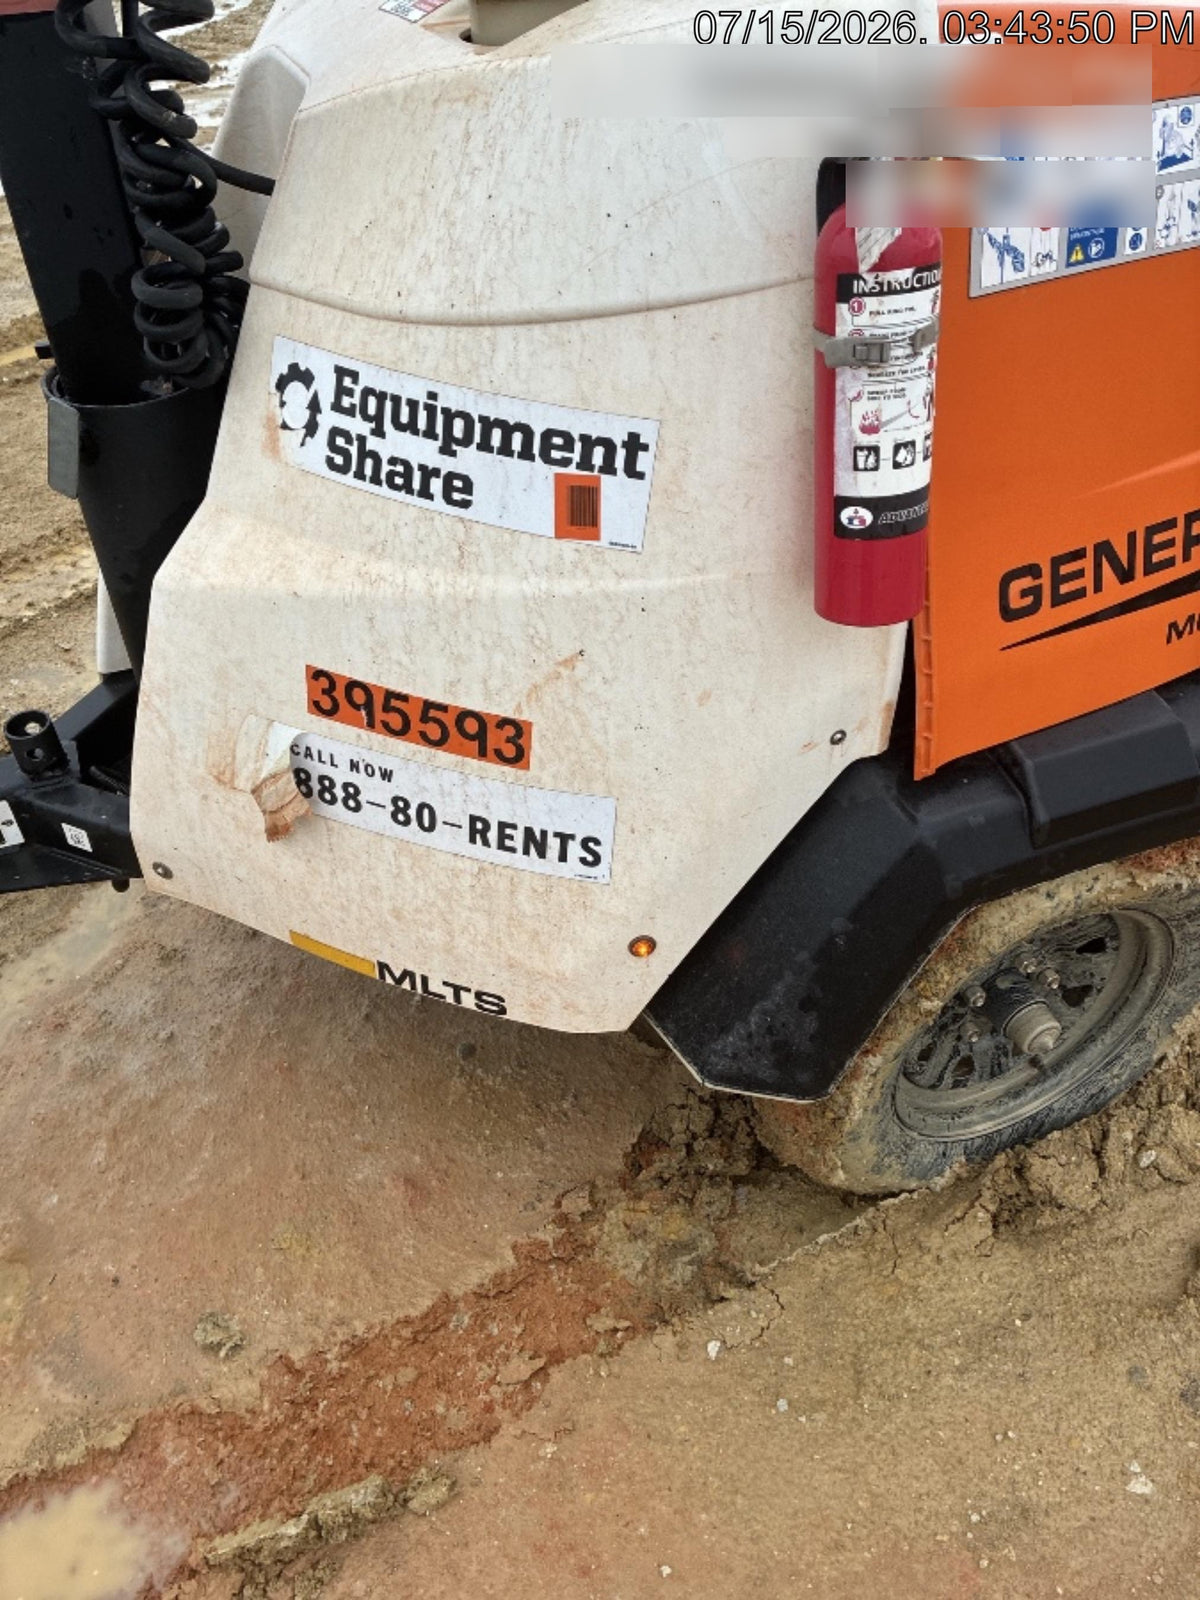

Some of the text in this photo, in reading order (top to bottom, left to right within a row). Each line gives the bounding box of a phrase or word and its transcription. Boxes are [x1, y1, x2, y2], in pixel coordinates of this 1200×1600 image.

[330, 365, 650, 480] Equipment
[325, 426, 474, 510] Share
[1166, 612, 1200, 644] M
[311, 669, 525, 765] 395593
[290, 743, 394, 782] CALL NOW
[292, 766, 603, 868] 888-80-RENTS
[377, 960, 508, 1015] MLTS
